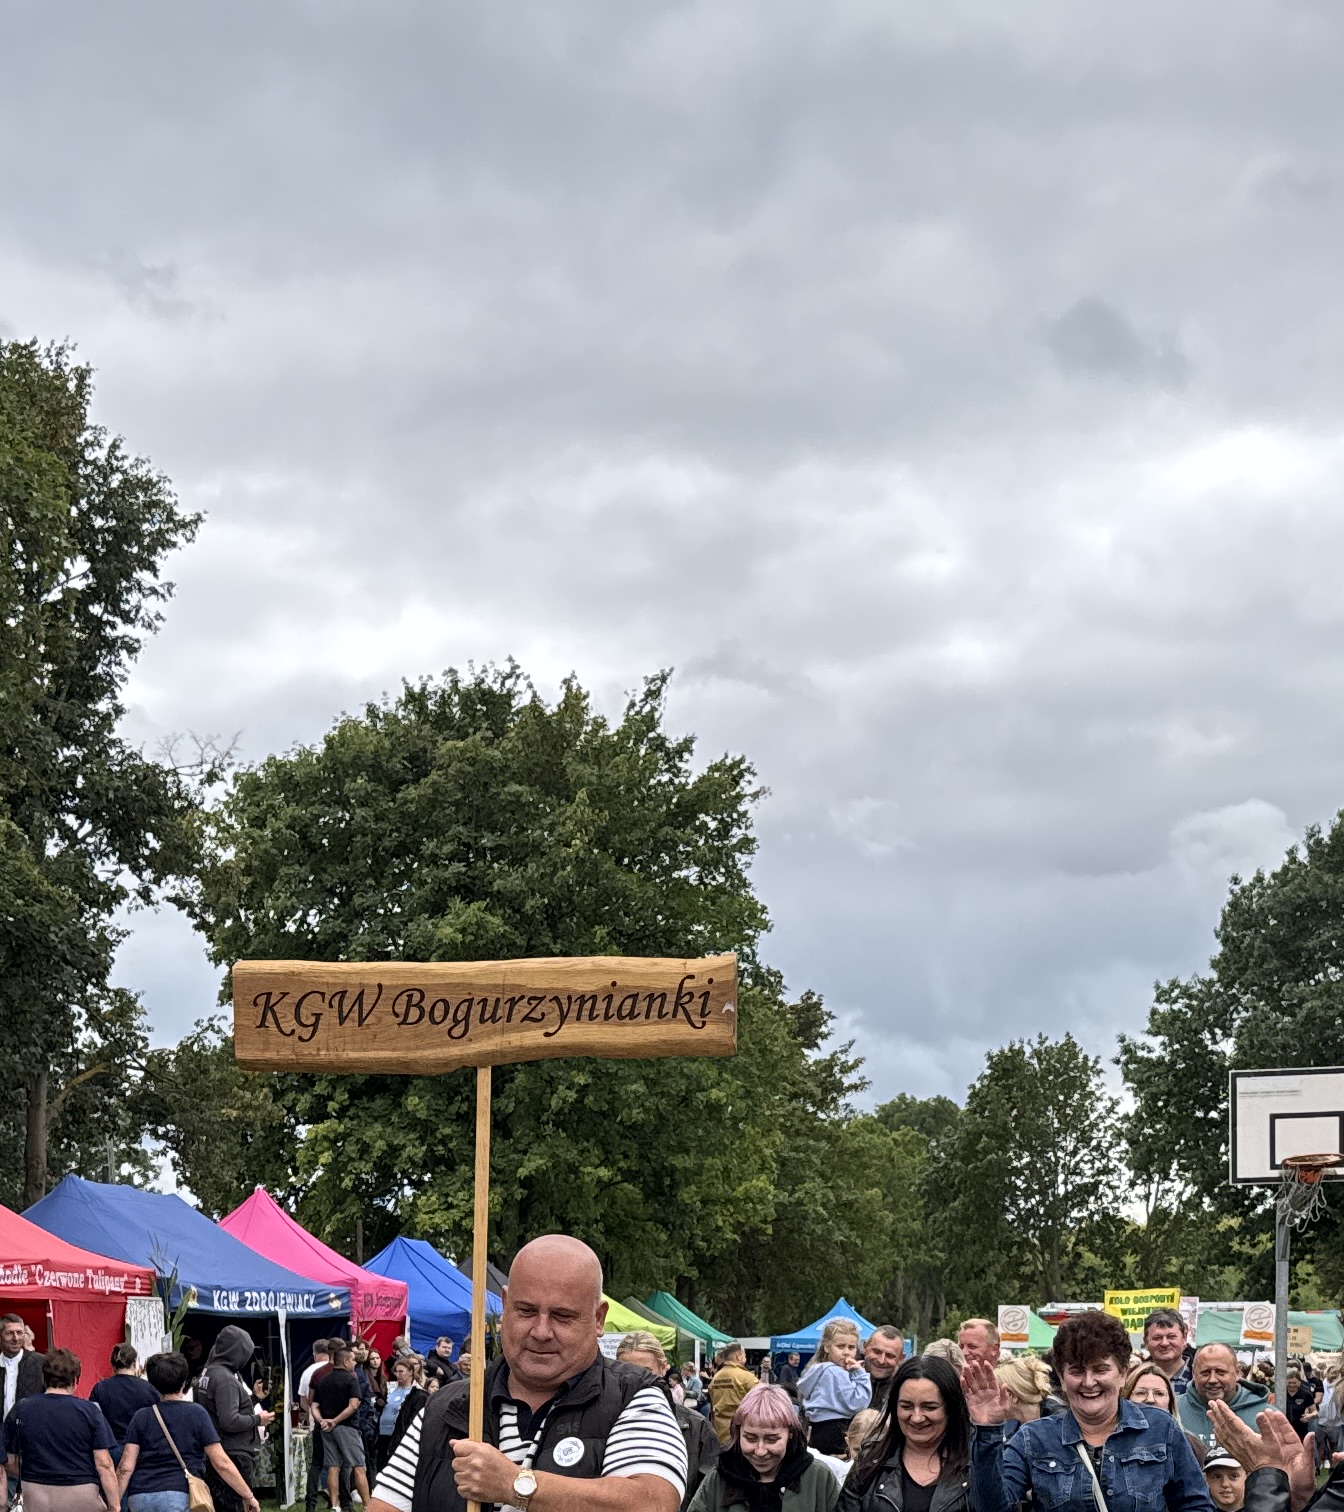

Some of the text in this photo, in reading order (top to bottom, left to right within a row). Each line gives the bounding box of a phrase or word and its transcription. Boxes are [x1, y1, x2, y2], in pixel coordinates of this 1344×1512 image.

[253, 974, 714, 1042] KGW Bogurzynianki
[212, 1290, 240, 1311] KGW
